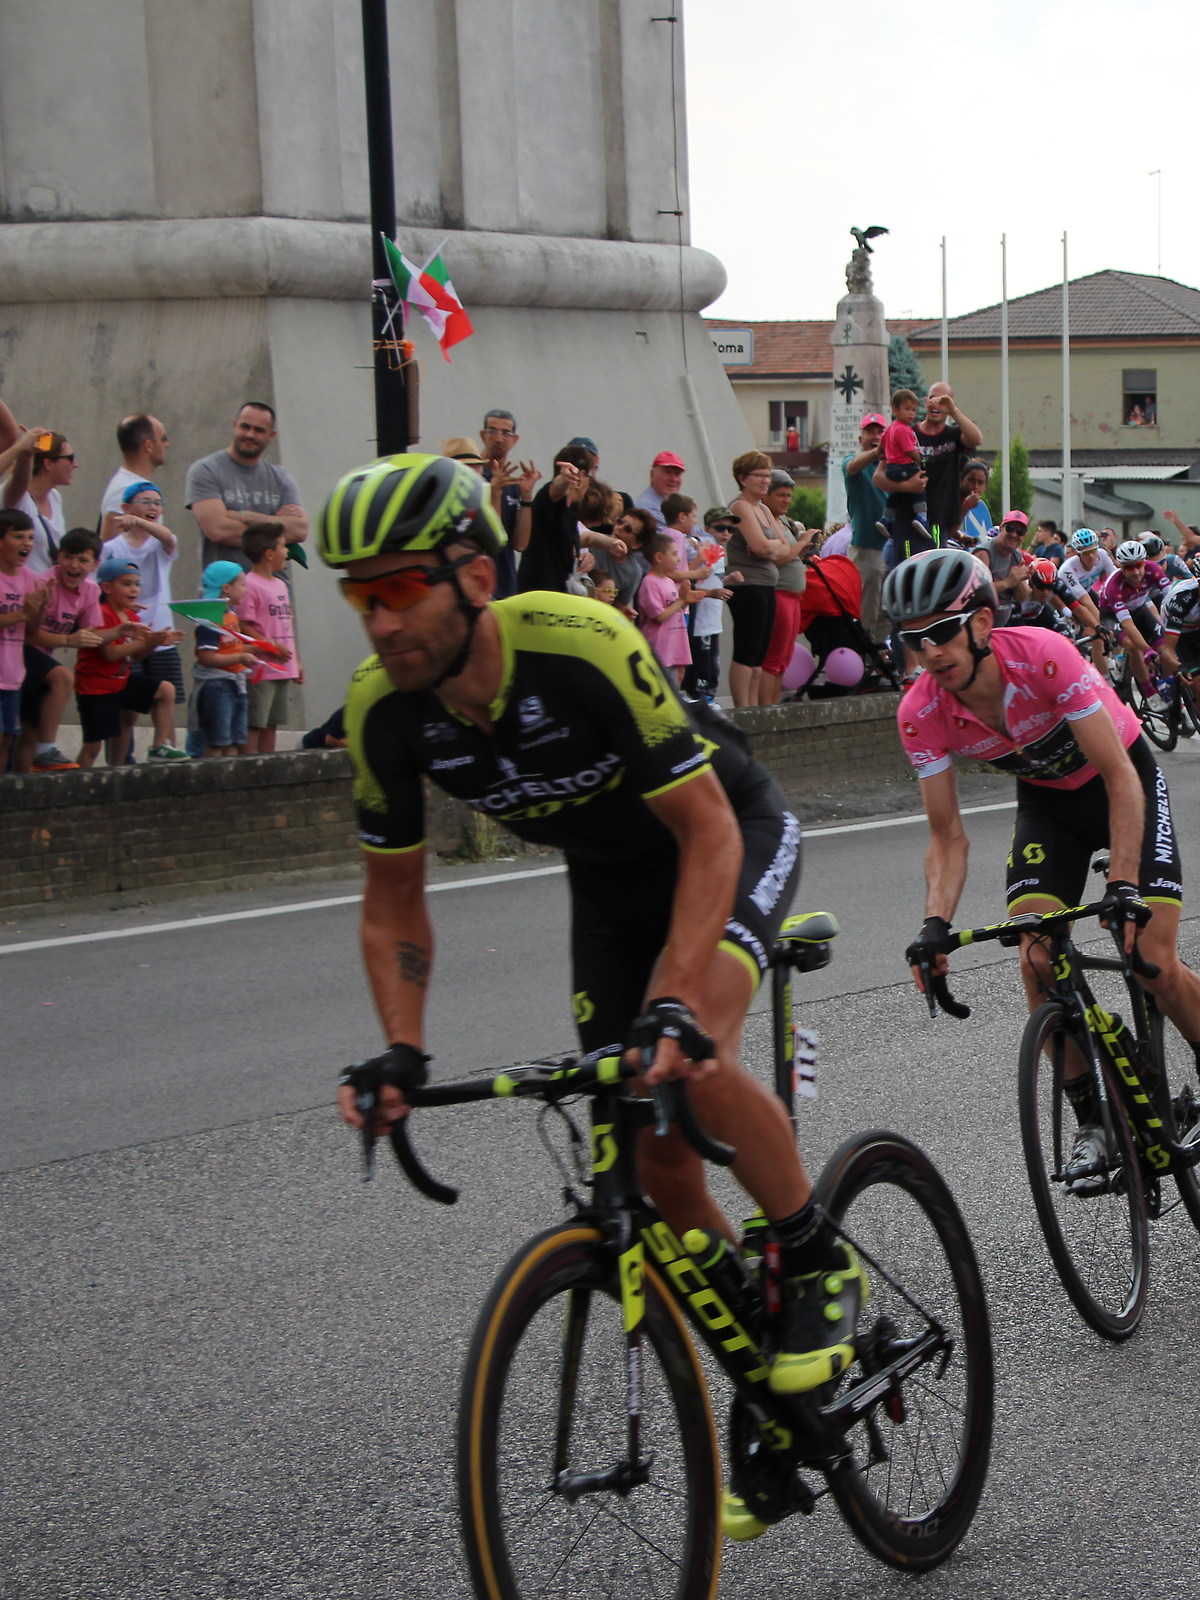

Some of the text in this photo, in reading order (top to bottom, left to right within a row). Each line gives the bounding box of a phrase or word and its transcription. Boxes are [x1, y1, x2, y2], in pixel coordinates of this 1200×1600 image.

[712, 341, 744, 353] oma
[1154, 766, 1173, 865] MITCHELTON
[1149, 876, 1184, 893] Jayc
[640, 1220, 772, 1383] SCOTT
